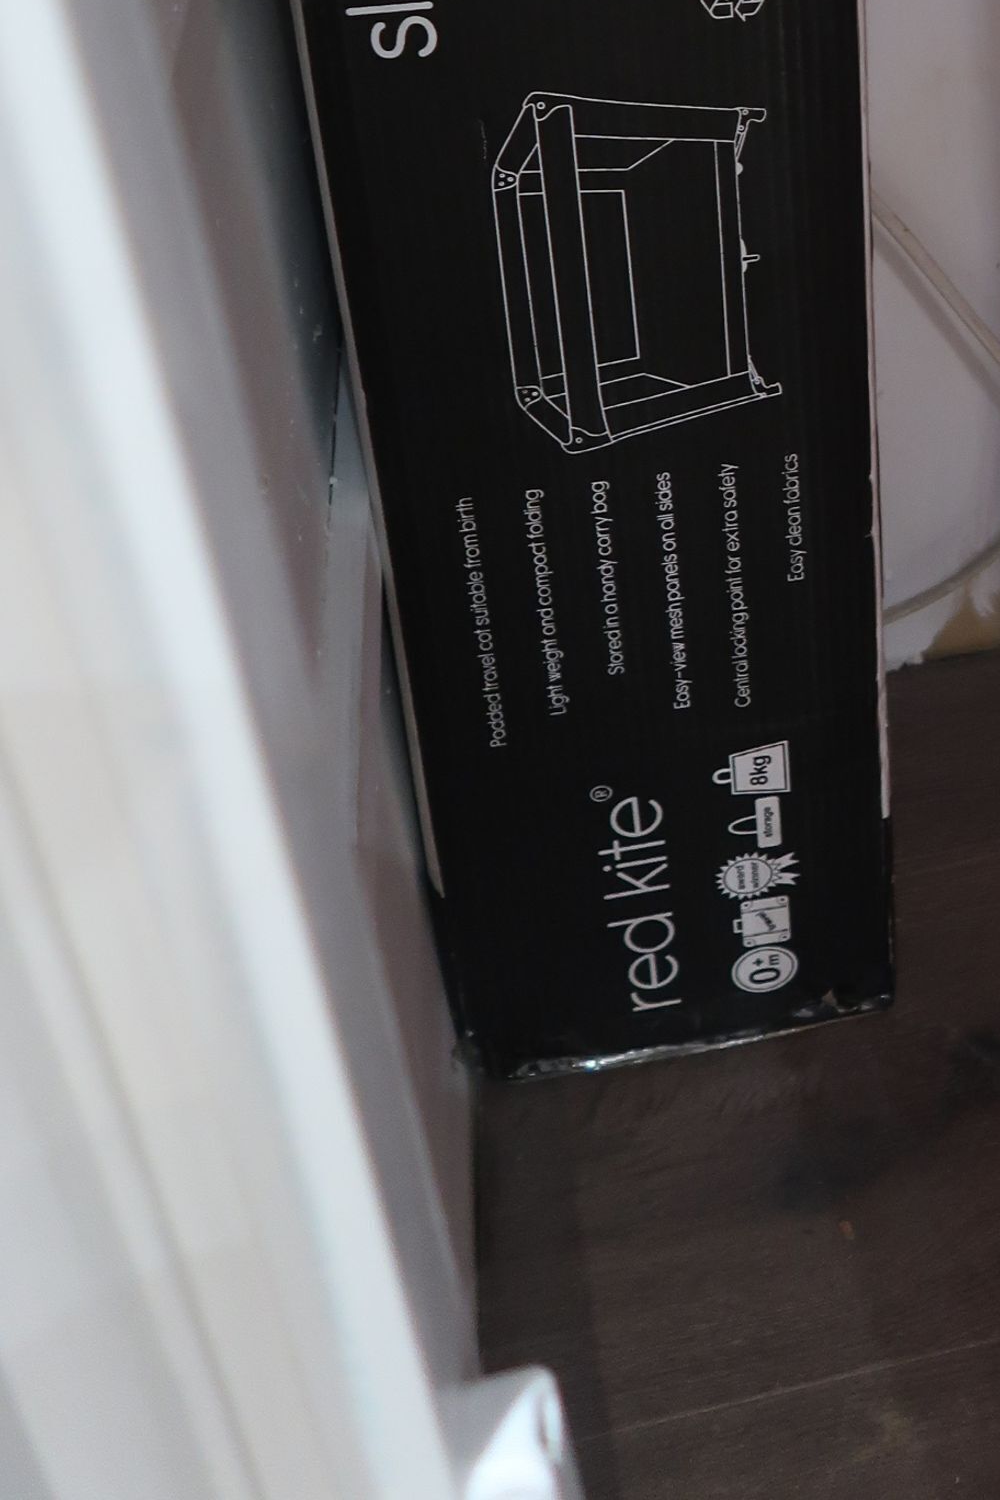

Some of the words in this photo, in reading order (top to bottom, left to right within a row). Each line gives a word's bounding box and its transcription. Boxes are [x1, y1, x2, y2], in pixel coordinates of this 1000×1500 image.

[588, 480, 611, 513] bag
[654, 471, 673, 511] sides
[718, 463, 742, 507] safety
[781, 453, 801, 504] fabrics
[455, 496, 477, 532] birth
[523, 488, 546, 539] folding
[657, 513, 675, 530] all
[722, 509, 741, 551] extra
[783, 506, 804, 546] clean
[461, 533, 481, 568] from
[592, 516, 617, 556] carry
[661, 533, 677, 551] on
[529, 542, 557, 605] compact
[597, 559, 622, 601] handy
[661, 553, 687, 601] panels
[724, 554, 742, 574] for
[787, 549, 808, 582] Easy
[466, 570, 491, 626] suitable
[605, 603, 619, 614] a
[724, 576, 749, 610] point
[474, 628, 494, 651] cot
[536, 608, 557, 635] and
[603, 616, 620, 628] in
[666, 603, 685, 639] mesh
[726, 612, 751, 658] locking
[477, 653, 499, 690] travel
[539, 638, 566, 681] weight
[603, 629, 626, 675] Stored
[670, 641, 693, 709] Easy-view
[729, 659, 752, 708] Central
[485, 692, 508, 747] Padded
[547, 685, 571, 716] Light
[749, 755, 772, 786] 8kg
[606, 911, 682, 1012] red
